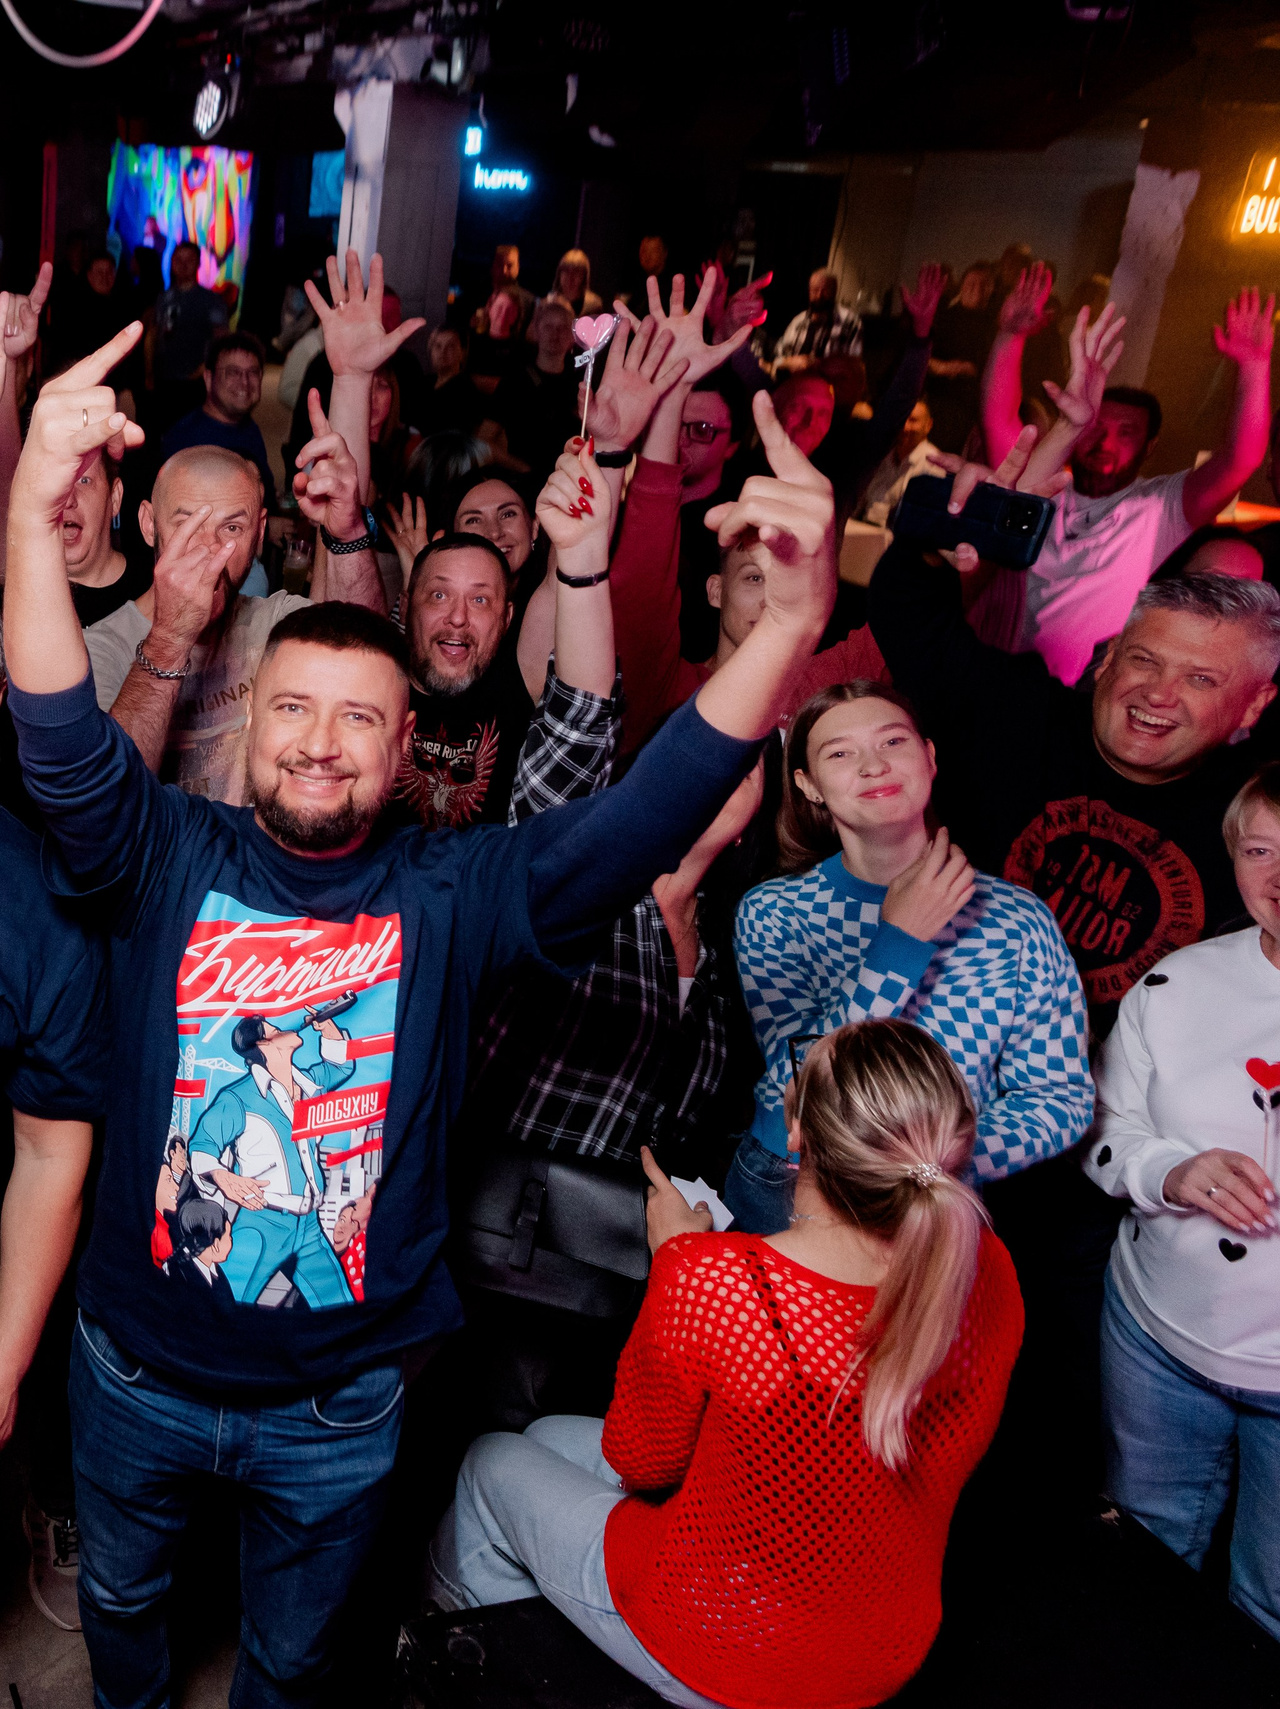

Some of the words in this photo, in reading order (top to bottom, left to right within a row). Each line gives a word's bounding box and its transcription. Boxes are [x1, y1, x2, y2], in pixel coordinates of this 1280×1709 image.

[1240, 194, 1280, 234] BUL
[1047, 883, 1131, 955] AILOR
[307, 1091, 379, 1130] ПОДБУХНУ
